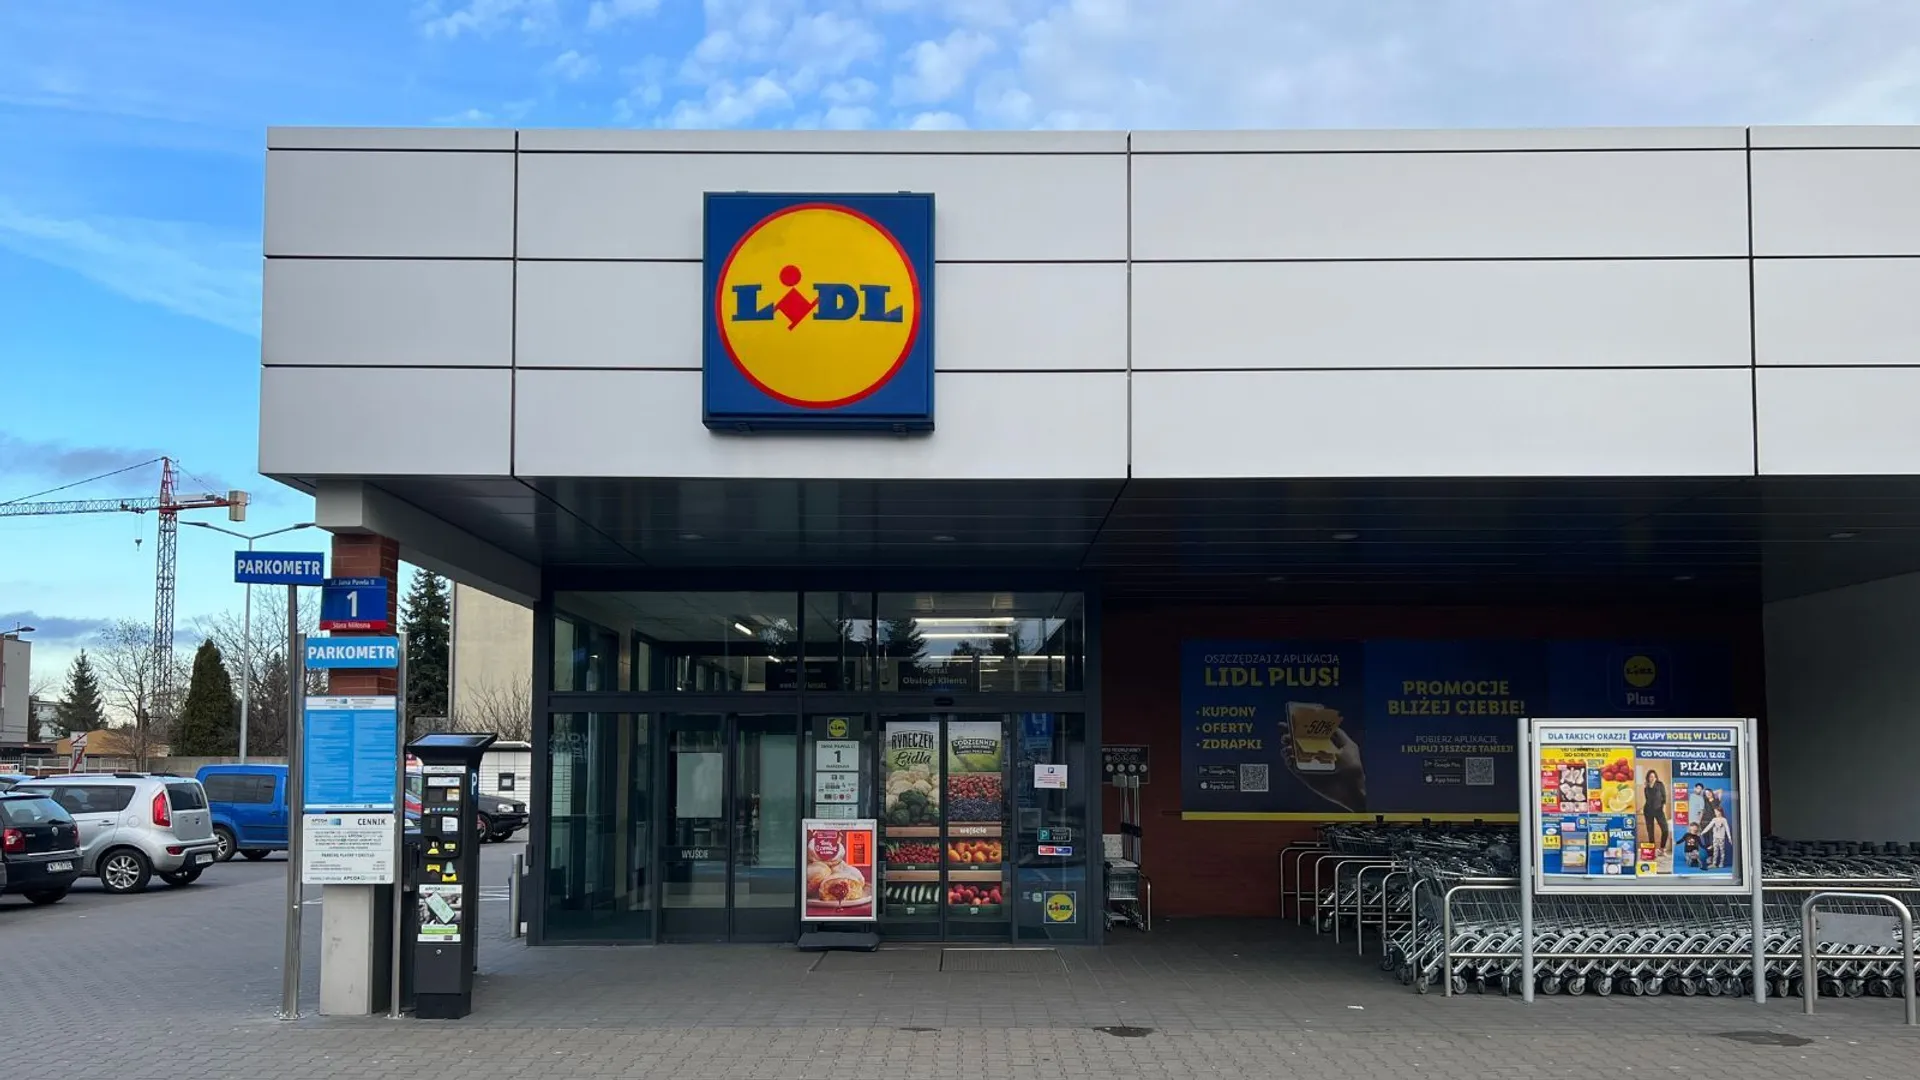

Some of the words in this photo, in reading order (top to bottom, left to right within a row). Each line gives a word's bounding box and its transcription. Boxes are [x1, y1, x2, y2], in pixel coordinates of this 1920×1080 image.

[237, 560, 320, 575] PARKOMETR
[346, 591, 358, 617] 1
[308, 645, 395, 660] PARKOMETR
[1204, 654, 1270, 666] OSZCZĘDZAJ
[1274, 654, 1282, 664] Z
[1284, 654, 1340, 666] APLIKACJĄ
[1204, 667, 1264, 686] LIDL
[1268, 667, 1340, 687] PLUS!
[1402, 680, 1510, 696] PROMOCJE
[1388, 696, 1450, 715] BLIŻEJ
[1455, 700, 1526, 715] CIEBIE!
[1626, 692, 1656, 706] Plus
[1202, 706, 1257, 718] KUPONY
[1202, 722, 1254, 734] OFERTY
[892, 733, 934, 750] RYNECZEK
[1632, 732, 1666, 740] ZAKUPY
[1202, 739, 1263, 750] ZDRAPKI
[834, 750, 842, 763] 1
[896, 752, 931, 767] Lidla
[1680, 760, 1724, 771] PIŻAMY
[357, 818, 386, 826] CENNIK
